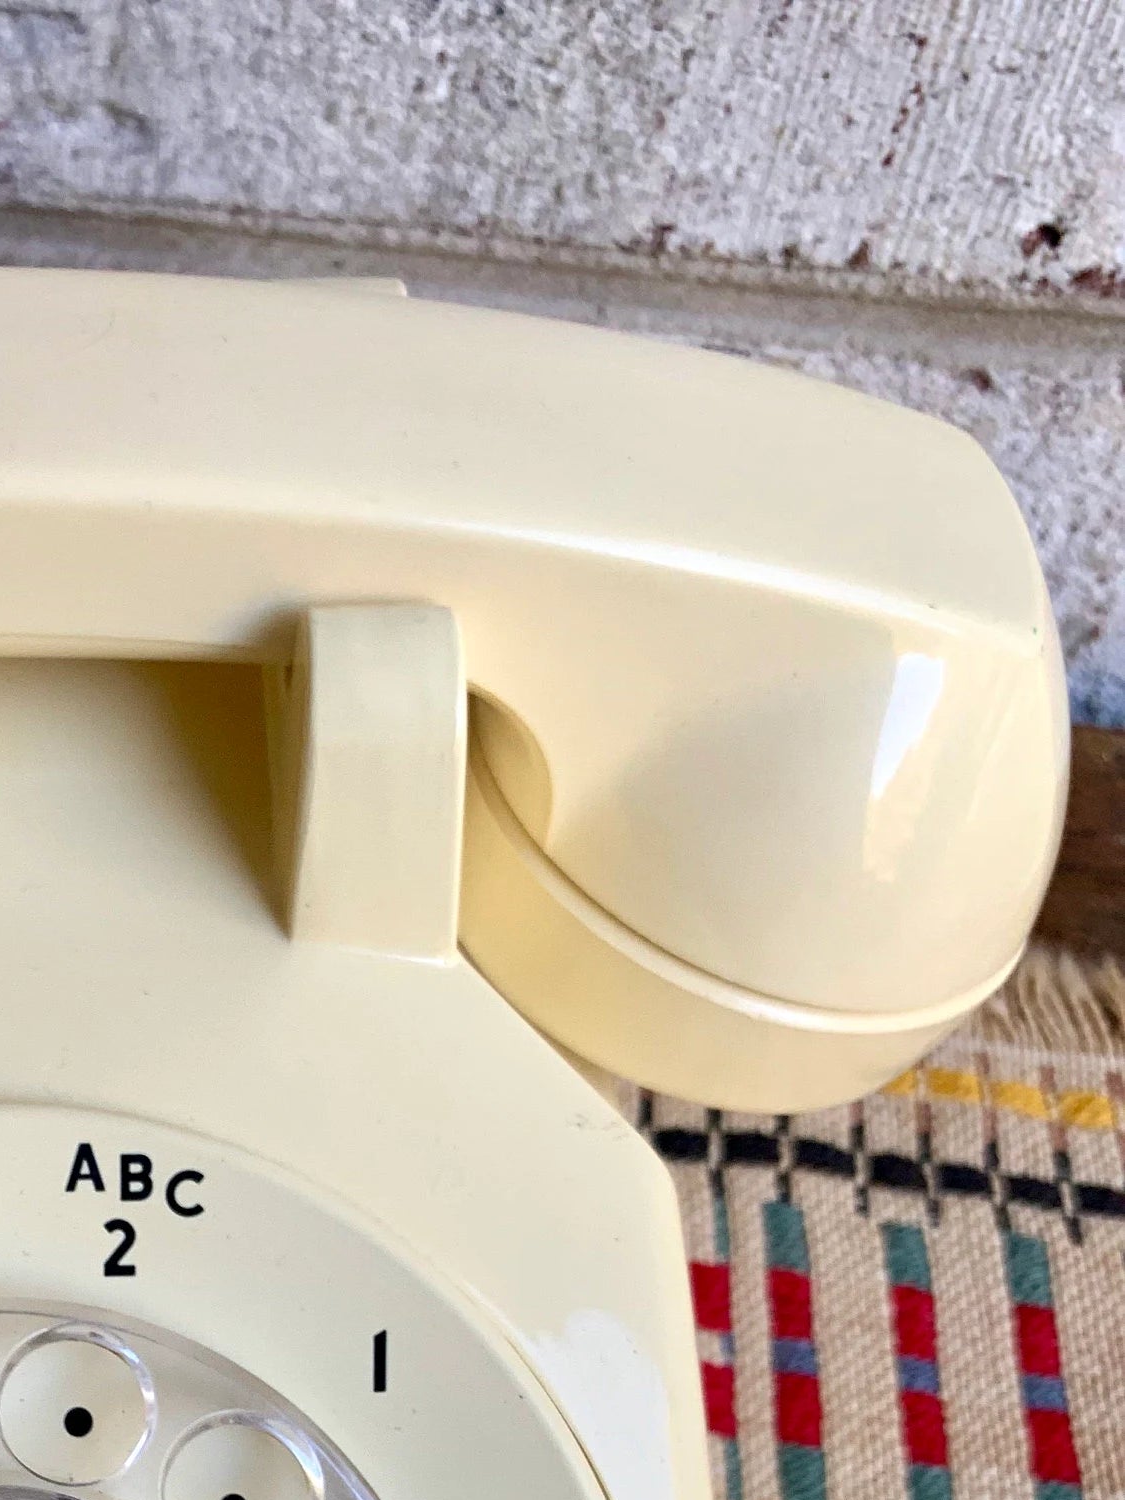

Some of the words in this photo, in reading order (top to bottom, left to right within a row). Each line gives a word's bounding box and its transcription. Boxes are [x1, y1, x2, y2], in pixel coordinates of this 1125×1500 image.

[65, 1142, 205, 1218] ABC
[103, 1218, 136, 1277] 2
[372, 1329, 388, 1393] 1
